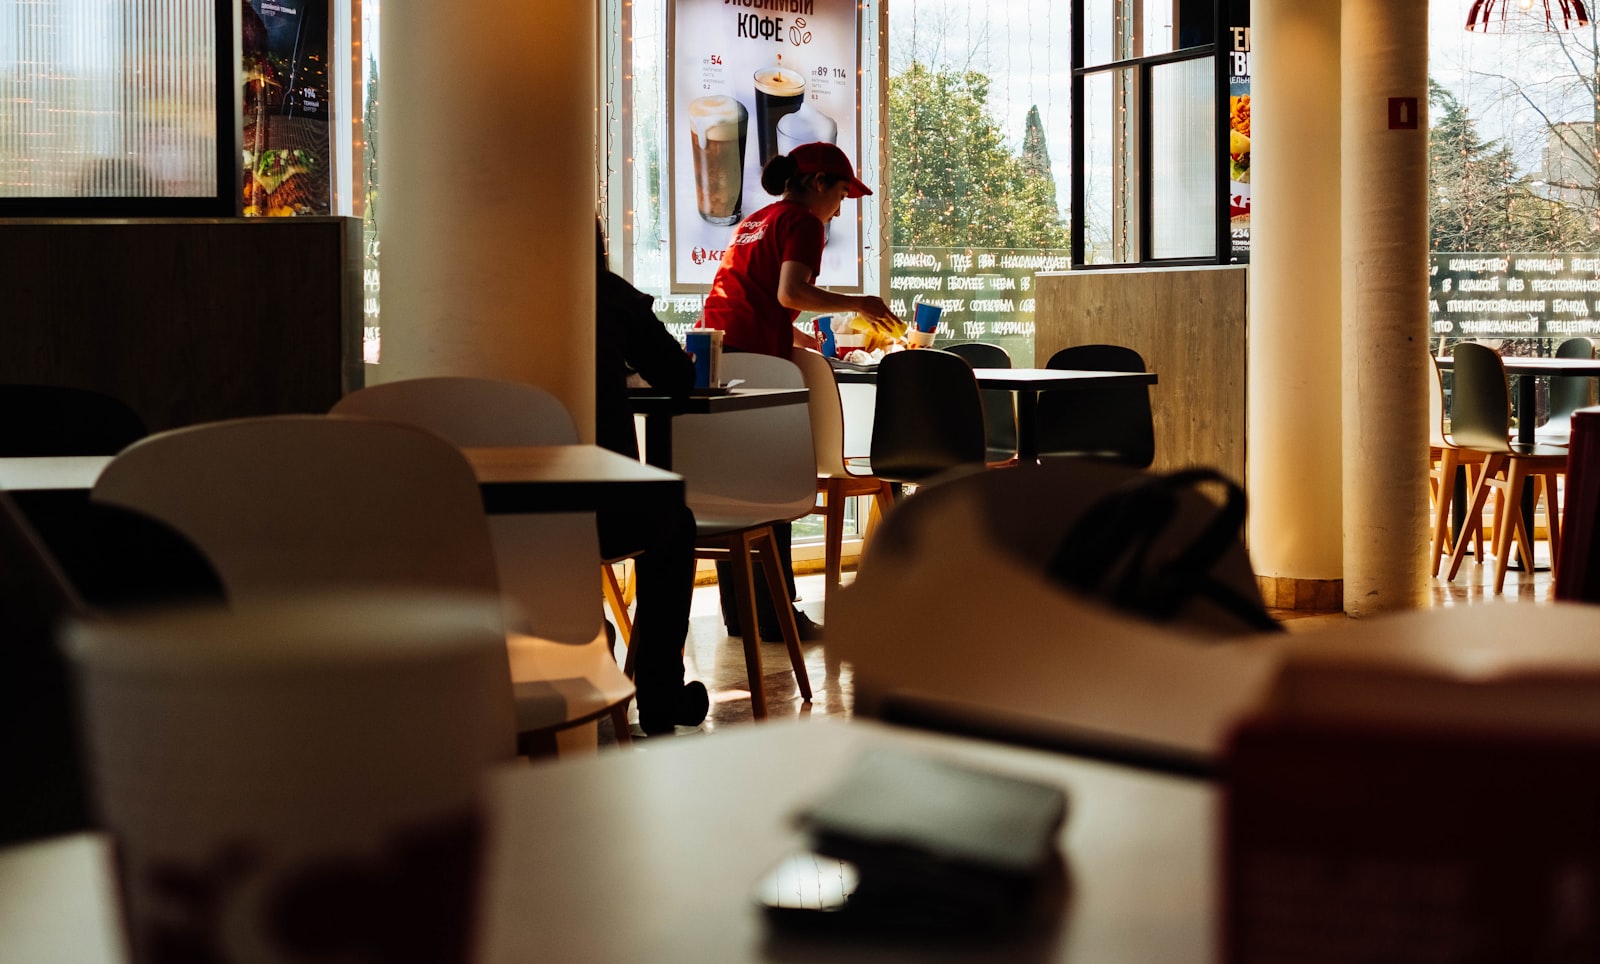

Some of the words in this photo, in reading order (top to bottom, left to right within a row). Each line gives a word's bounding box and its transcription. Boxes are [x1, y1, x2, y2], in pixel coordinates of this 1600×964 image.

[738, 13, 784, 42] КОФЕ
[711, 54, 722, 65] 54
[818, 66, 828, 76] 89
[833, 68, 846, 78] 114
[304, 88, 316, 99] 194
[1232, 228, 1249, 238] 234
[1458, 276, 1500, 292] КАКОЙ
[1446, 299, 1545, 312] ПРИГОТОВЛЕНИЯ
[1459, 315, 1538, 333] УНИКАЛЬНОЙ
